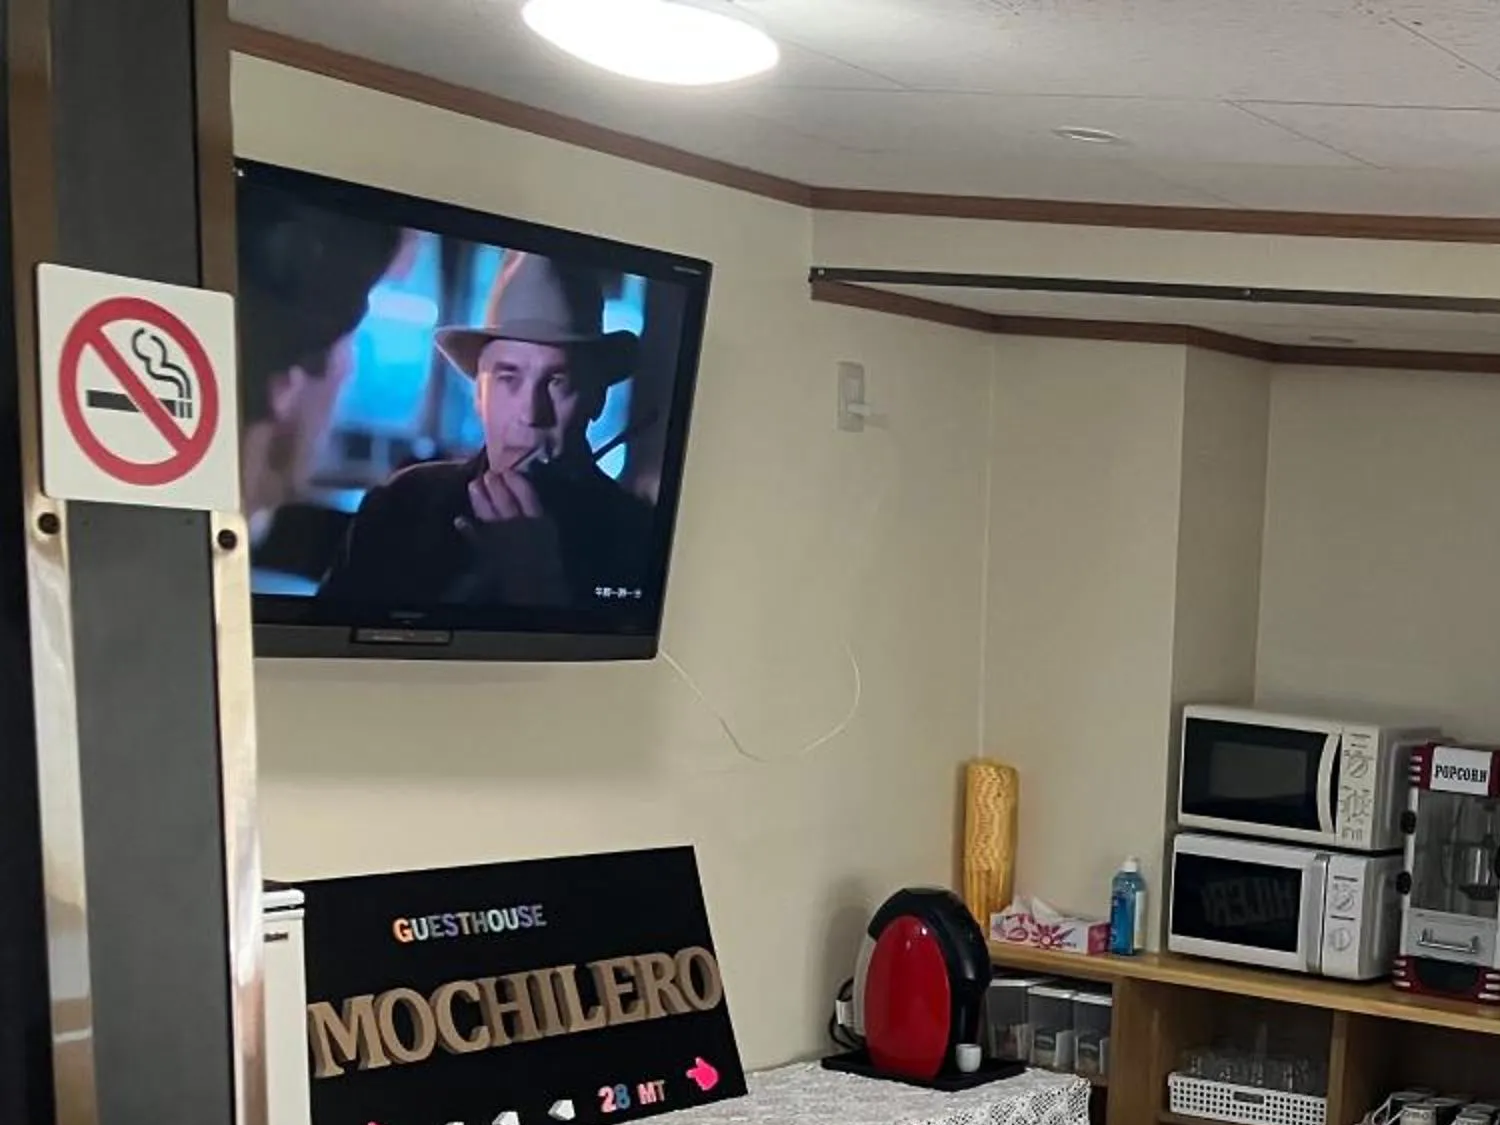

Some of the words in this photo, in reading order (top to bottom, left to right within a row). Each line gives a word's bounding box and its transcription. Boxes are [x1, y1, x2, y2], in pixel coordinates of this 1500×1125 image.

[1434, 763, 1488, 783] POPCORN
[392, 903, 548, 943] GUESTHOUSE
[306, 945, 723, 1079] MOCHILERO
[598, 1083, 631, 1113] 28
[637, 1079, 666, 1105] MT
